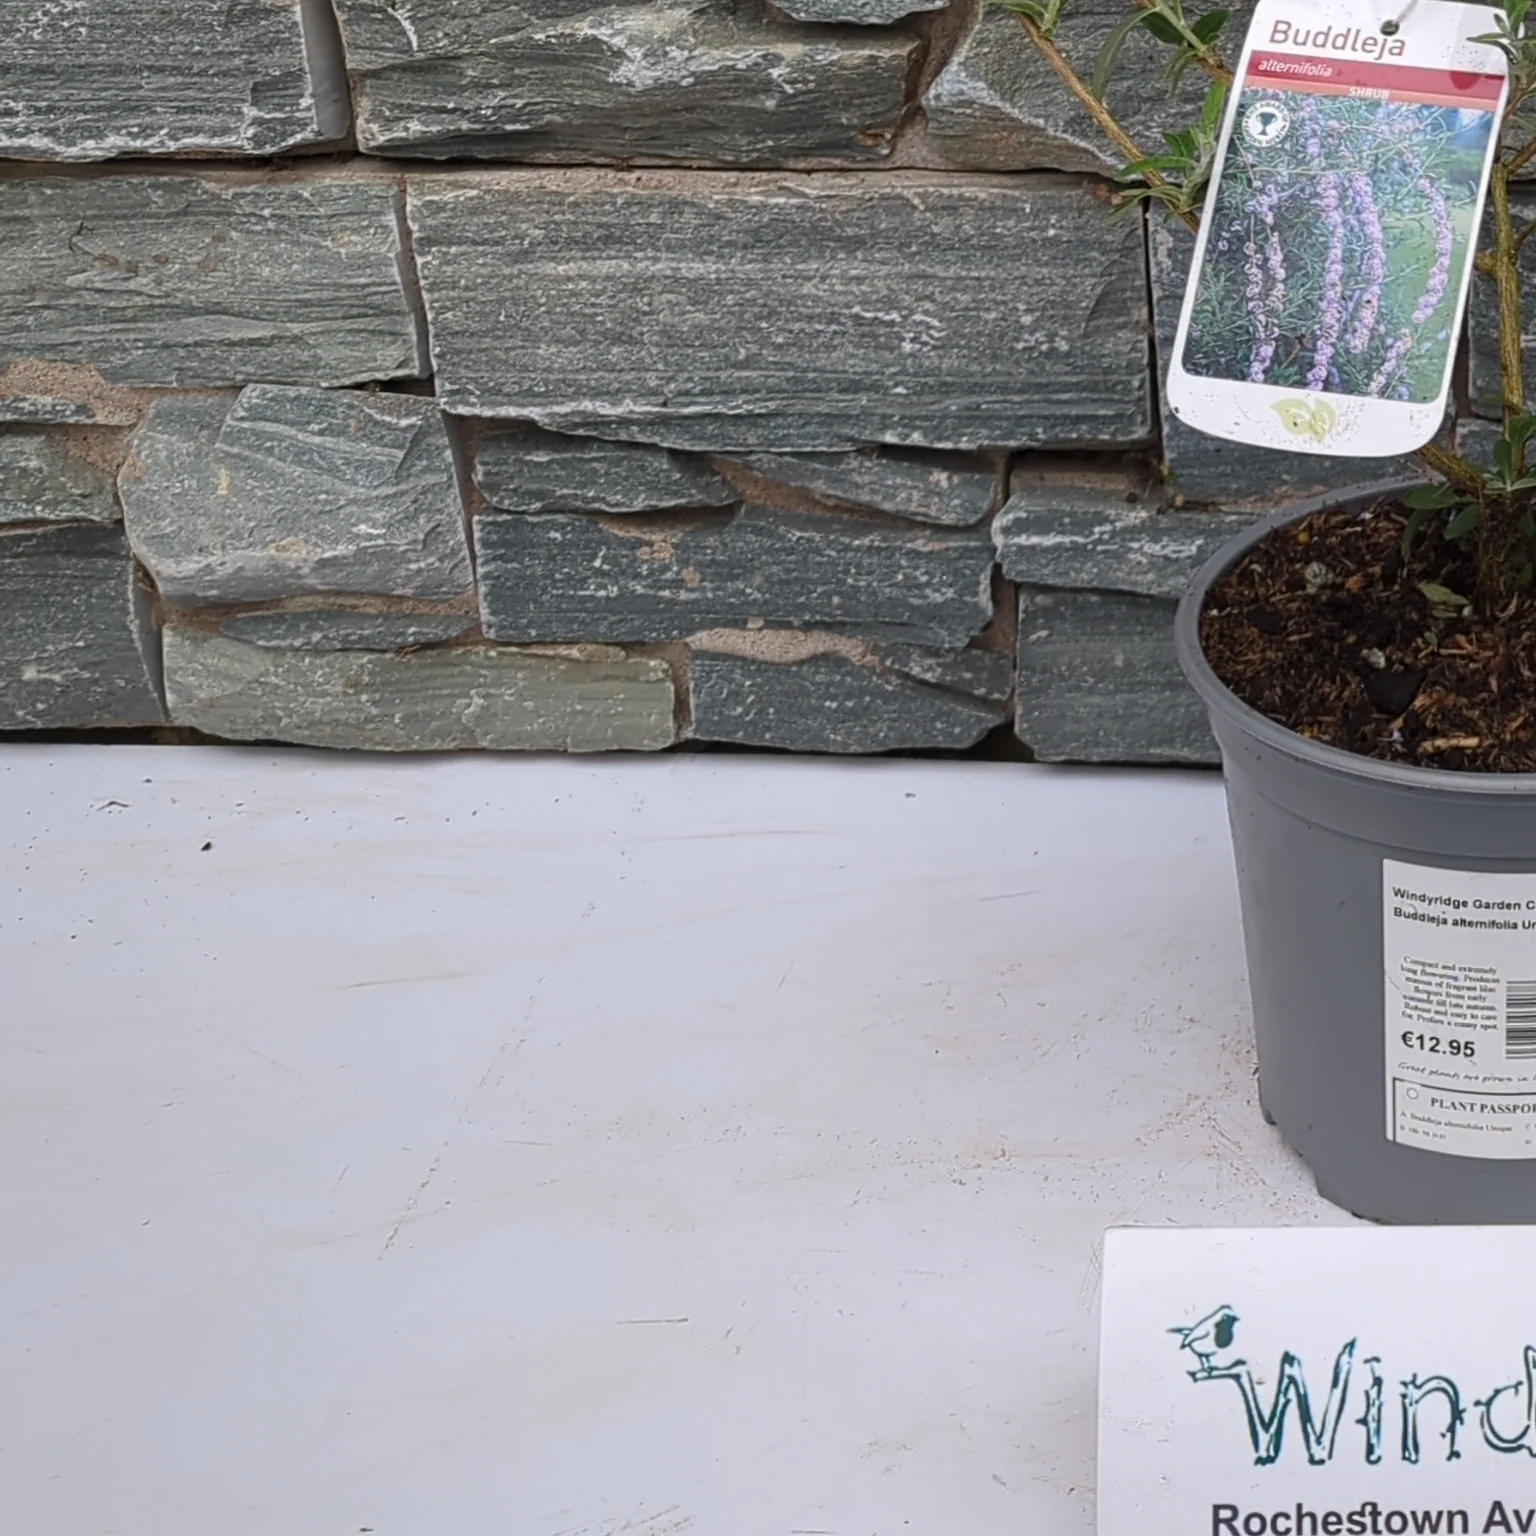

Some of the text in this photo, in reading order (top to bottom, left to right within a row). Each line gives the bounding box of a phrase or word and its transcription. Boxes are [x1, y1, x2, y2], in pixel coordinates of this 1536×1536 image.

[1269, 20, 1405, 61] Buddleja
[1259, 59, 1332, 77] alternifolia
[1348, 86, 1391, 100] SHRUB
[1393, 887, 1468, 909] Windyridge
[1473, 899, 1521, 910] Garden
[1393, 906, 1448, 926] Buddleja
[1452, 917, 1518, 929] alternifolia
[1404, 956, 1438, 968] Compact
[1401, 1030, 1475, 1058] €12.95
[1398, 1062, 1426, 1074] Great
[1431, 1097, 1477, 1113] PLANT
[1211, 1501, 1470, 1536] Rochestown
